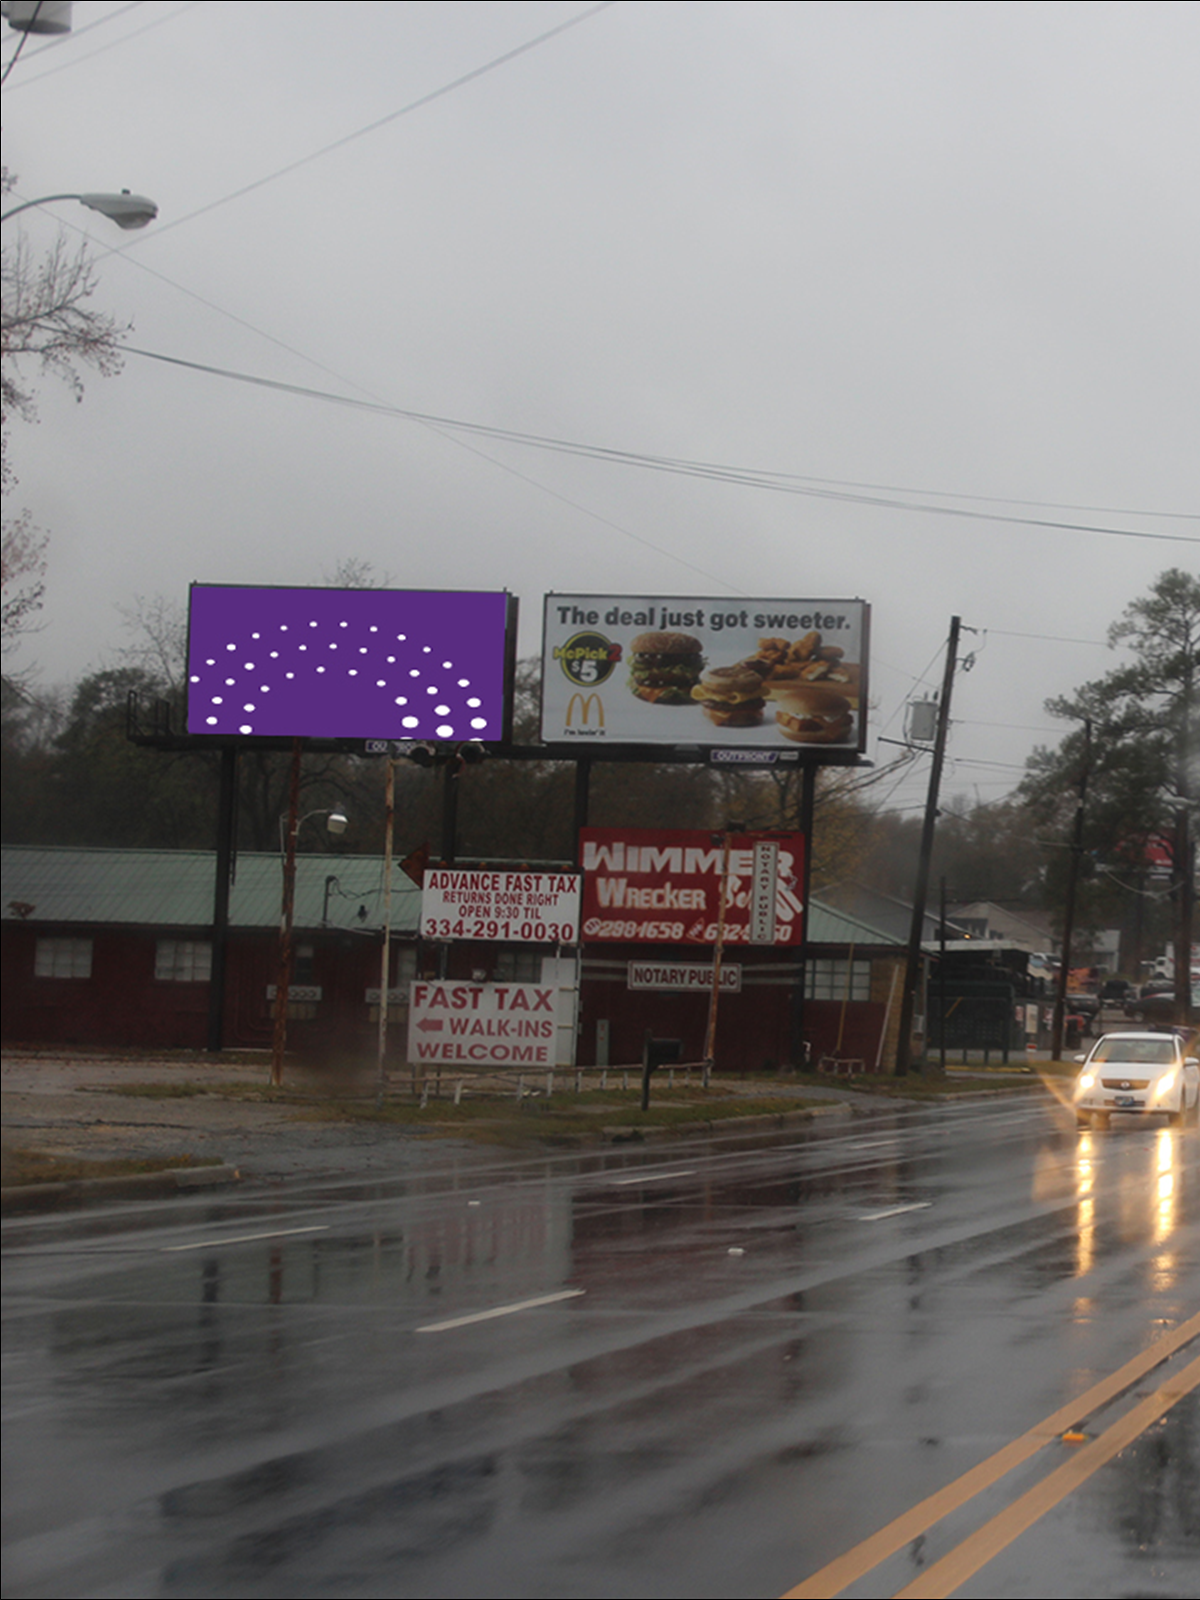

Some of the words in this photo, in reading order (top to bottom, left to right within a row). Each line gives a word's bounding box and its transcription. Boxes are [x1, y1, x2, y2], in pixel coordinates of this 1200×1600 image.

[557, 606, 599, 625] The
[605, 607, 654, 626] deal
[660, 608, 704, 630] just
[710, 610, 748, 631] got
[754, 611, 851, 630] sweeter.
[552, 646, 608, 660] McPick
[760, 846, 771, 890] NOTARY
[429, 872, 500, 891] ADVANCE
[505, 874, 543, 892] FAST
[548, 875, 577, 893] TAX
[443, 891, 491, 904] RETURNS
[494, 892, 523, 905] DONE
[526, 893, 559, 906] RIGHT
[459, 905, 491, 918] OPEN
[494, 906, 520, 919] 9:30
[523, 907, 541, 919] TIL
[757, 896, 769, 940] PUBLIC
[426, 918, 573, 941] 334-291-0030
[634, 968, 686, 984] NOTARY
[414, 985, 484, 1010] FAST
[494, 988, 553, 1012] TAX
[449, 1018, 553, 1038] WALK-INS
[417, 1042, 548, 1062] WELCOME
